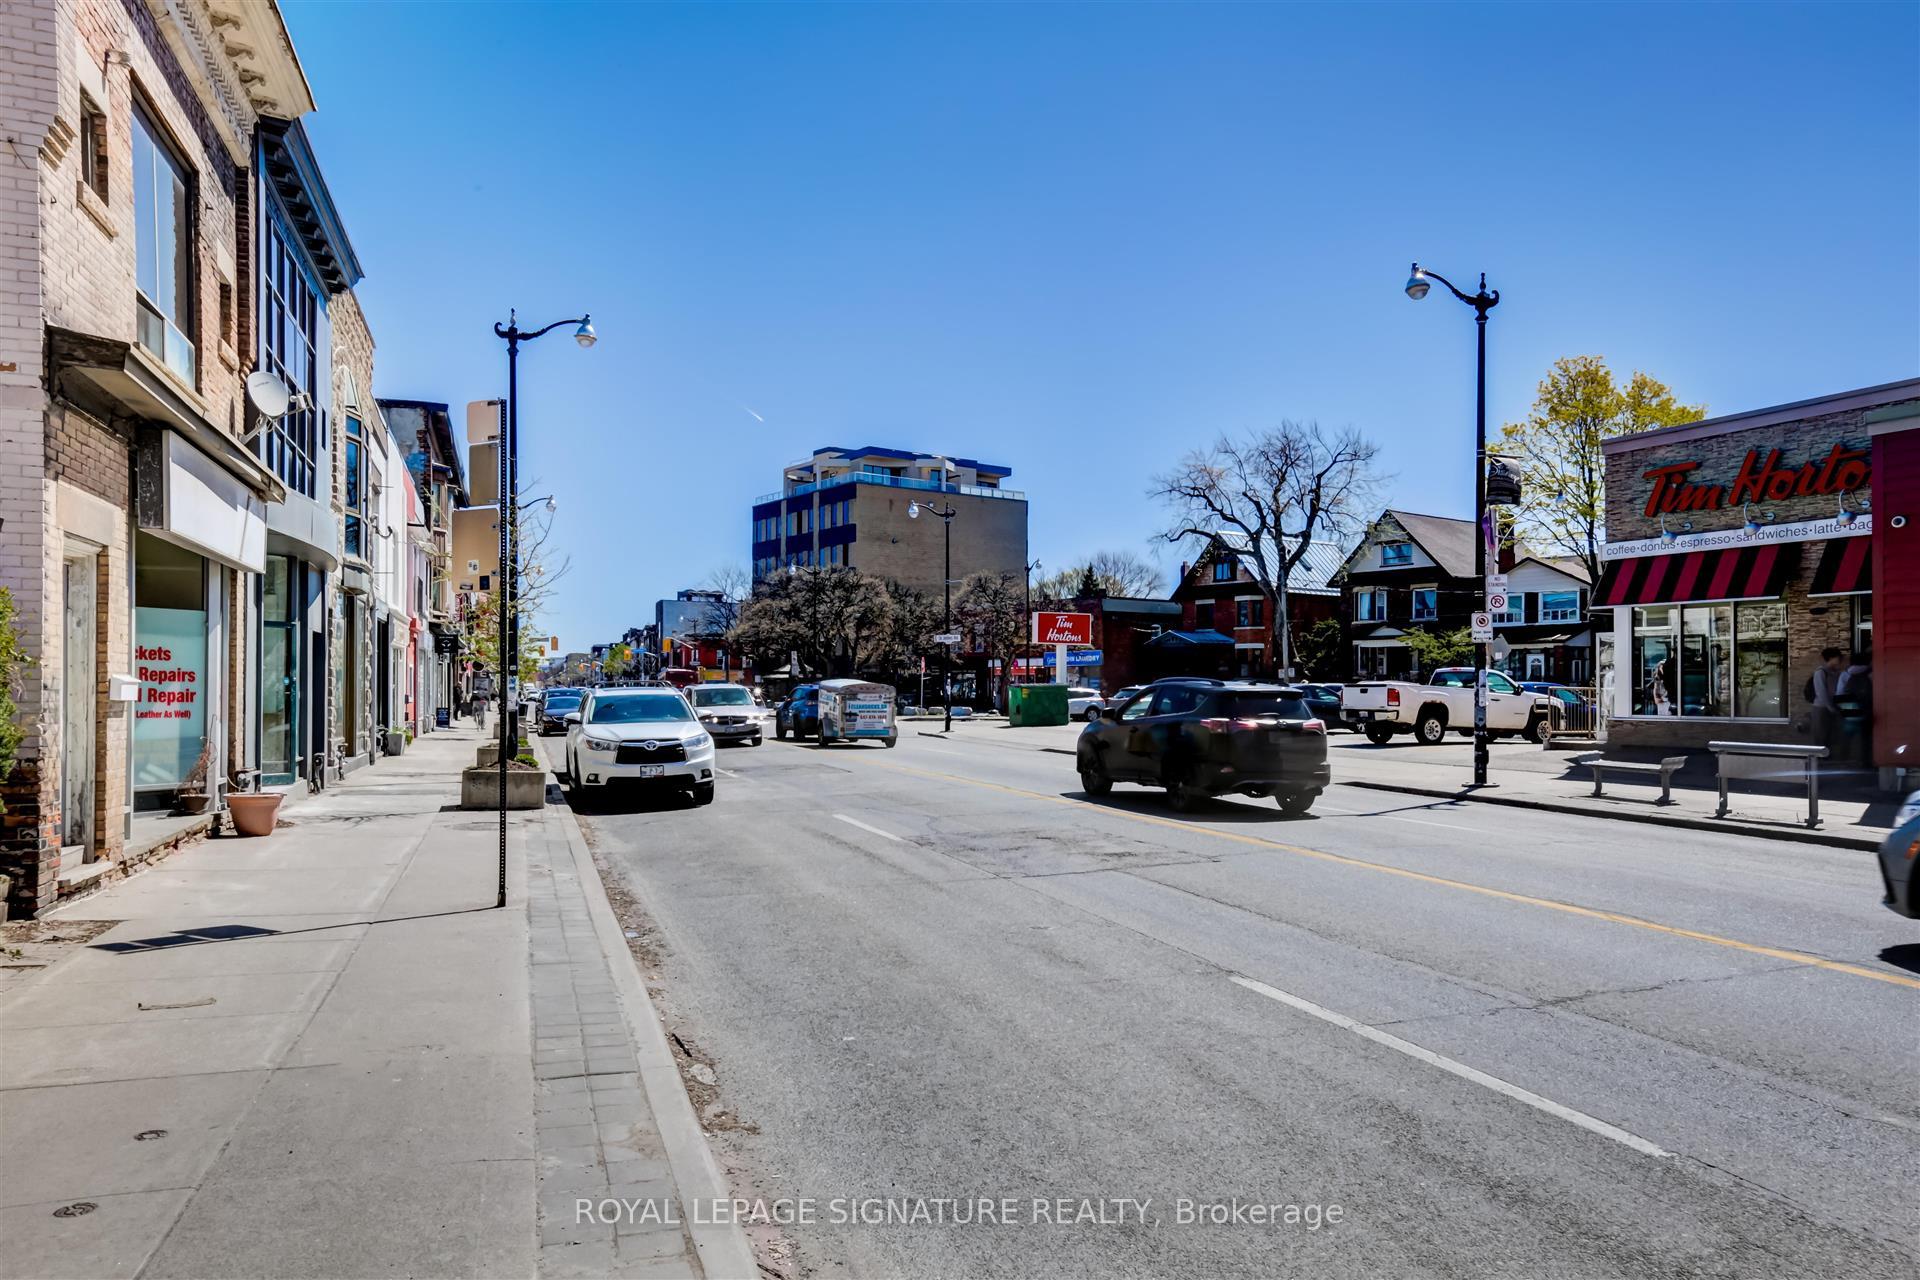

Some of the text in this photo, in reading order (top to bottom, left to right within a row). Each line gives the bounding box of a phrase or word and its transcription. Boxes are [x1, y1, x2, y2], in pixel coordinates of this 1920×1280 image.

[1642, 443, 1872, 517] Tim Horto
[1606, 544, 1638, 556] coffee
[1680, 535, 1731, 549] espresso
[1814, 522, 1841, 534] latte
[1056, 615, 1073, 629] Tim
[1046, 628, 1082, 642] Hortons
[139, 666, 196, 685] Repairs
[148, 688, 196, 706] Repair
[136, 710, 191, 719] Leather As Well)
